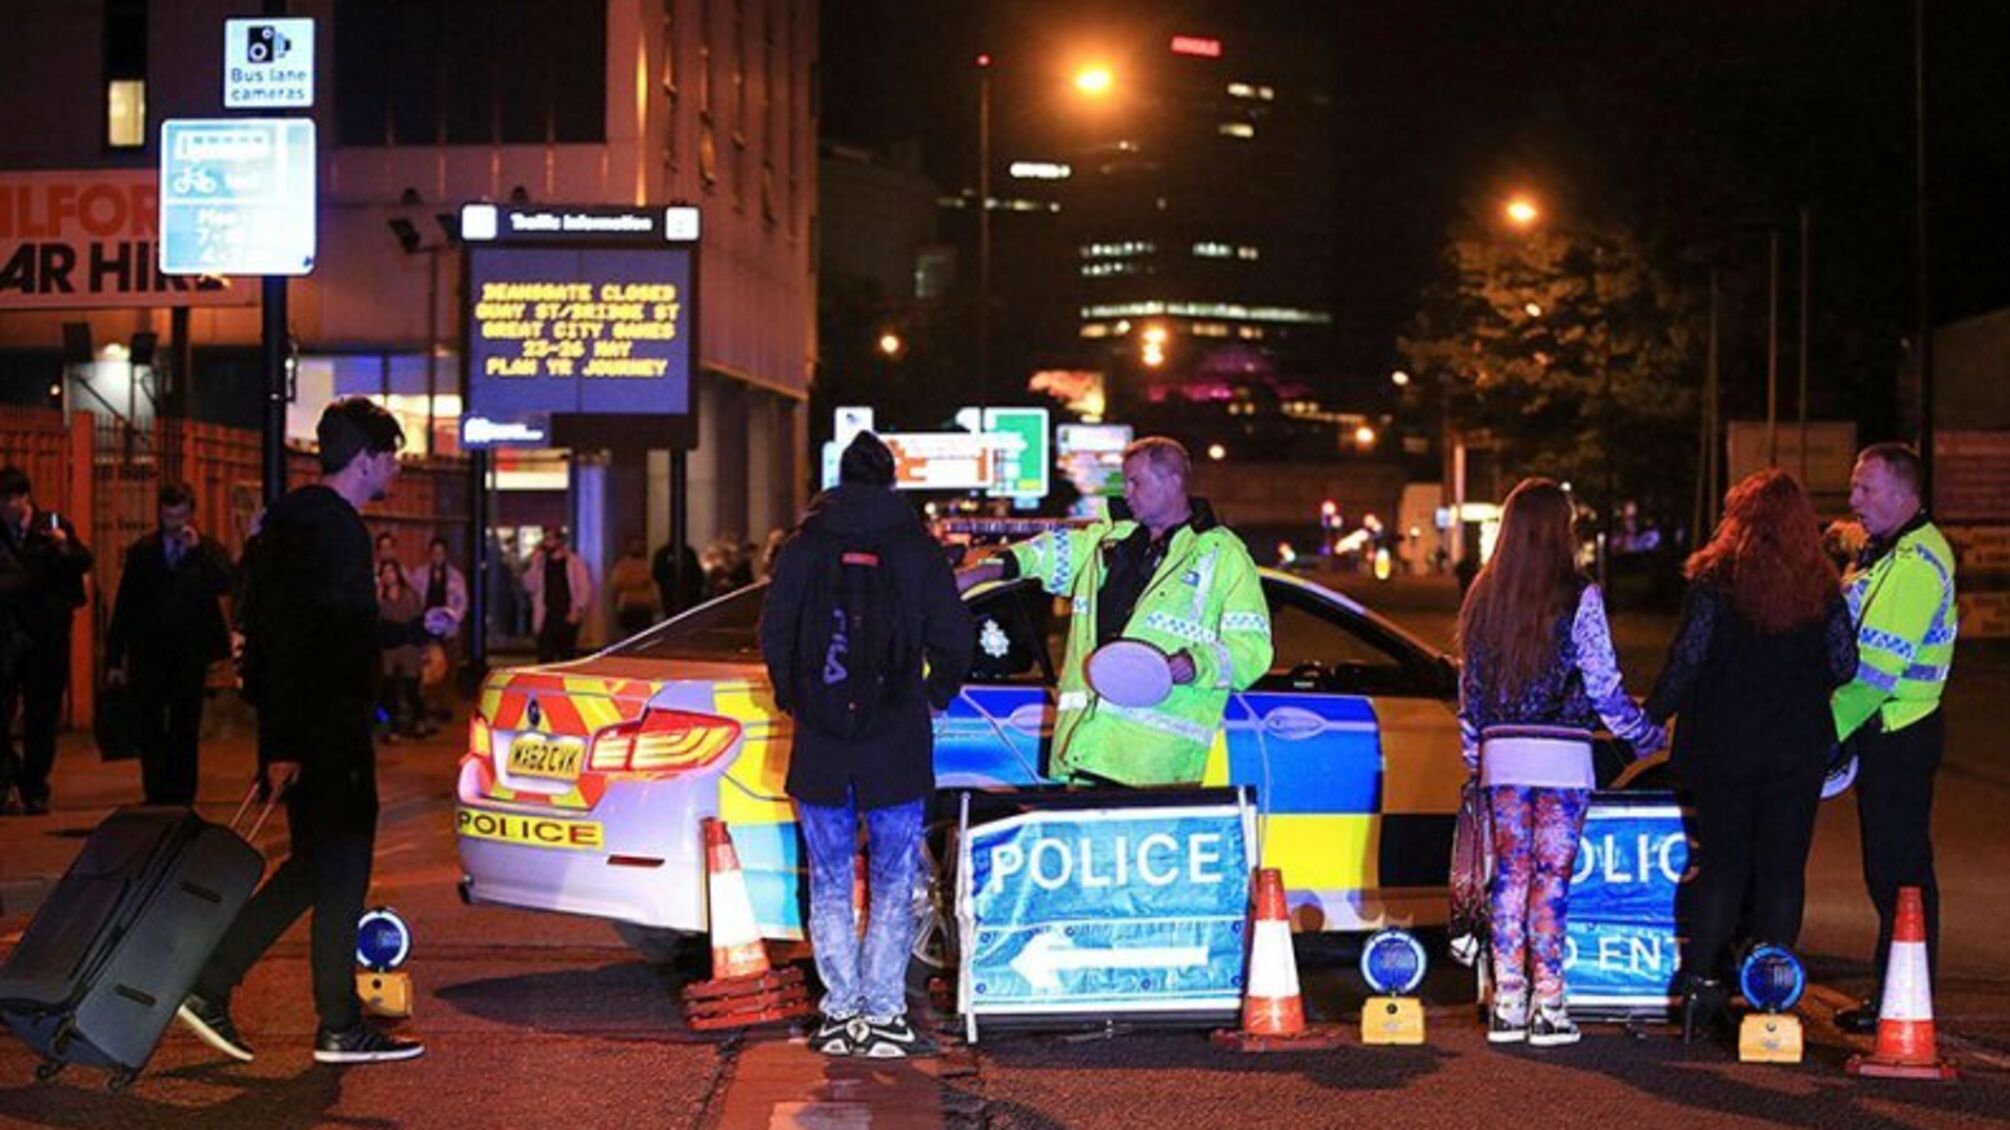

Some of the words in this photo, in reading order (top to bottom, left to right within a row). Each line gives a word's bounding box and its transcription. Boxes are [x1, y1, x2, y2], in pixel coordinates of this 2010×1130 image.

[231, 67, 263, 83] Bus
[270, 67, 306, 82] lane
[230, 88, 305, 101] cameras
[511, 213, 560, 230] Traffic
[563, 215, 652, 230] Information
[601, 284, 675, 301] CLOSED
[654, 304, 680, 320] ST
[482, 322, 543, 338] GREAT
[553, 322, 604, 338] CITY
[612, 323, 675, 339] GAMES
[594, 341, 632, 357] MAY
[486, 358, 537, 375] PLAN
[546, 359, 573, 375] YR
[582, 360, 667, 377] JOURNEY
[457, 812, 600, 846] POLICE
[990, 833, 1223, 893] POLICE
